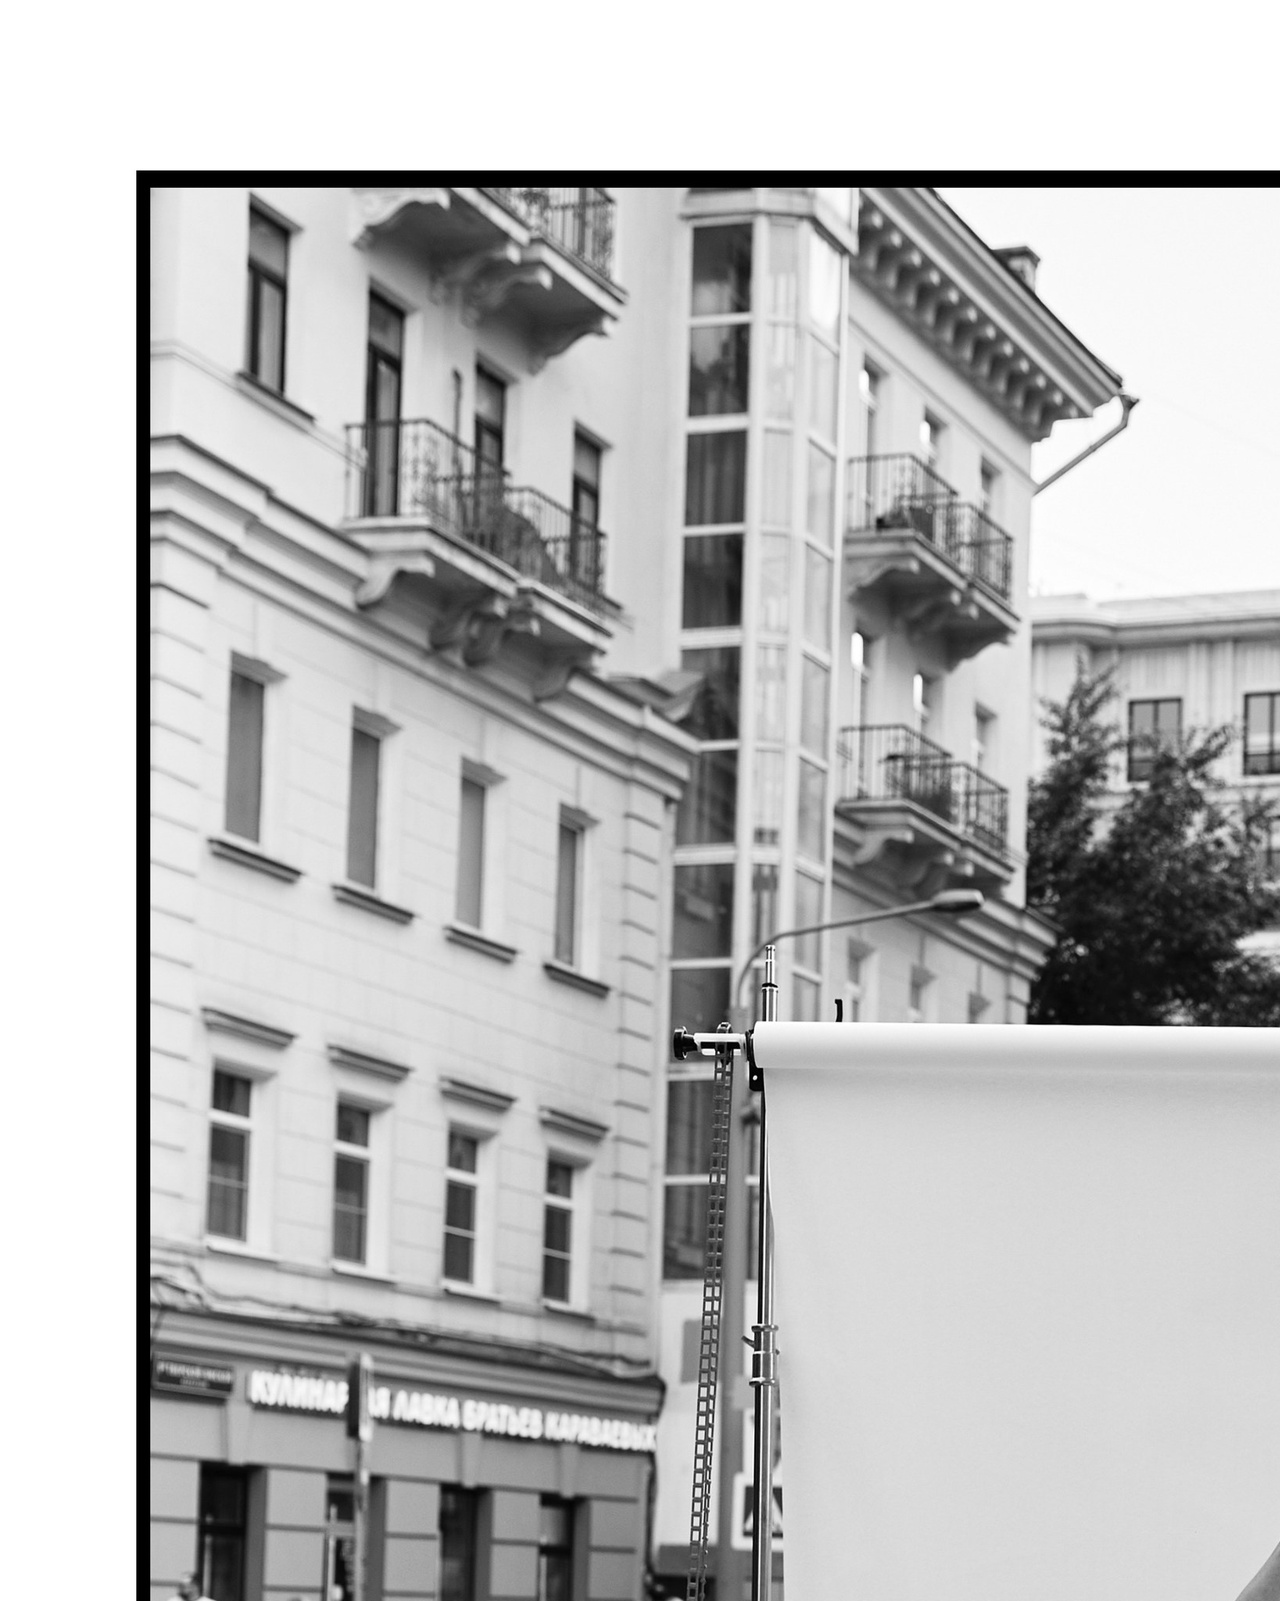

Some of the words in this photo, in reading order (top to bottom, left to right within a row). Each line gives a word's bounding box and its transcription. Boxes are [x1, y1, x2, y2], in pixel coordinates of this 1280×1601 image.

[251, 1370, 390, 1419] КУЛИНАРЯ
[392, 1389, 460, 1429] ЛАВКА
[462, 1399, 543, 1440] БРАТЬЕВ
[545, 1411, 657, 1452] КАРАВАЕВЫХ
